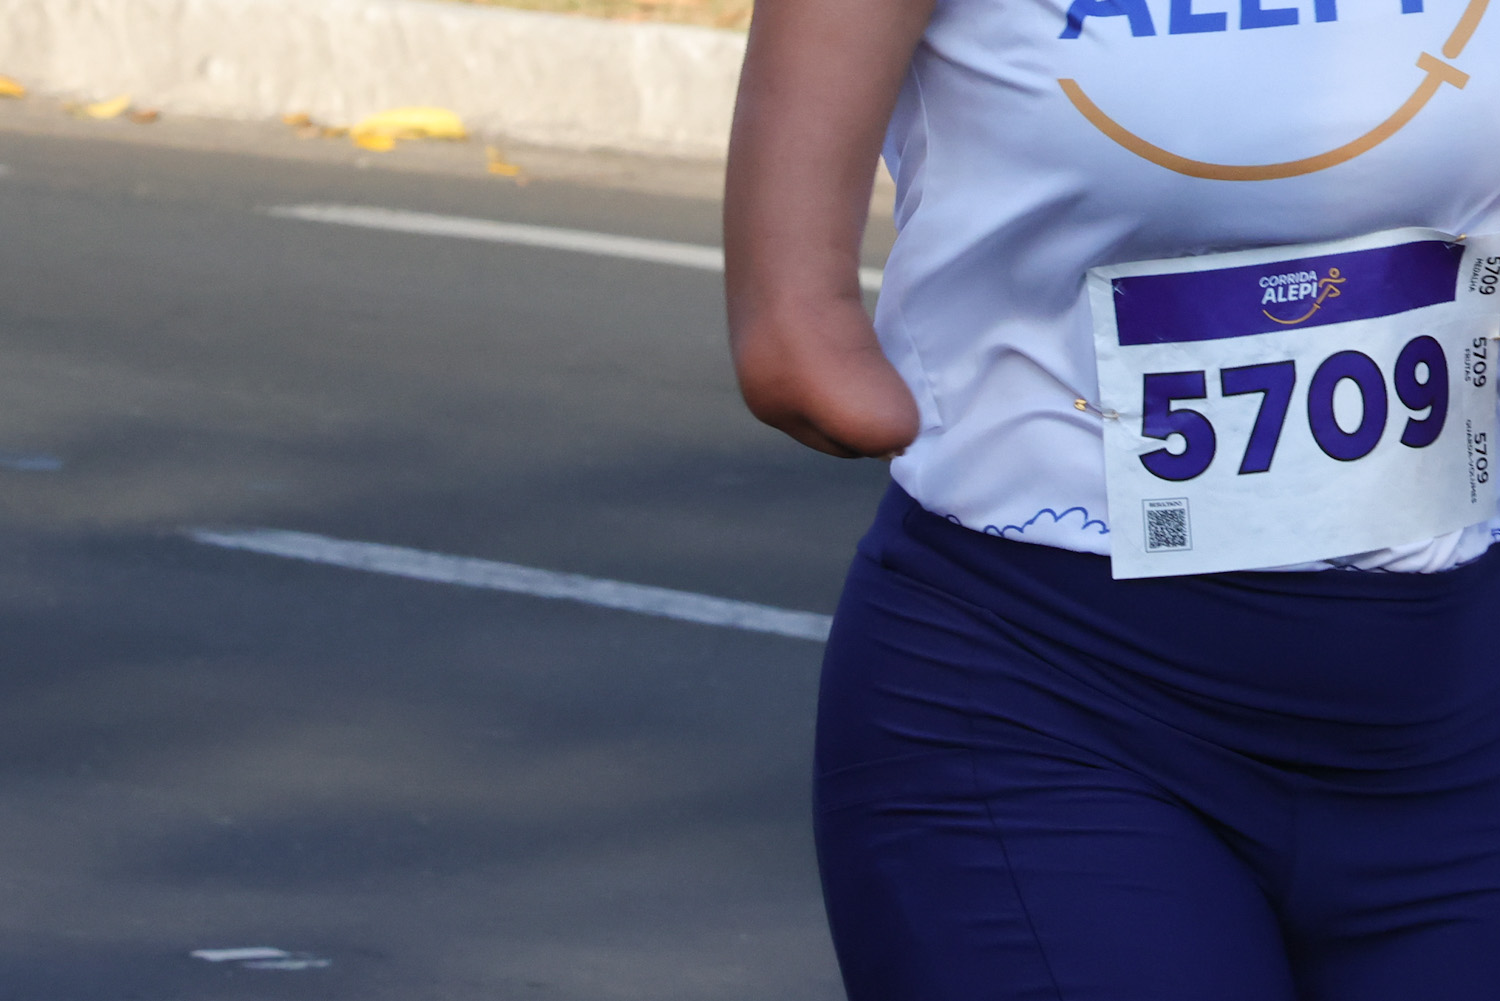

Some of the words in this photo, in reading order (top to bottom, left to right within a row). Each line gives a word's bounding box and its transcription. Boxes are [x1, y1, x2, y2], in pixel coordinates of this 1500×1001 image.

[1259, 270, 1318, 288] CORRIDA
[1261, 281, 1318, 305] ALEPI
[1472, 337, 1488, 388] 5709
[1139, 335, 1449, 481] 5709
[1474, 432, 1489, 484] 5709
